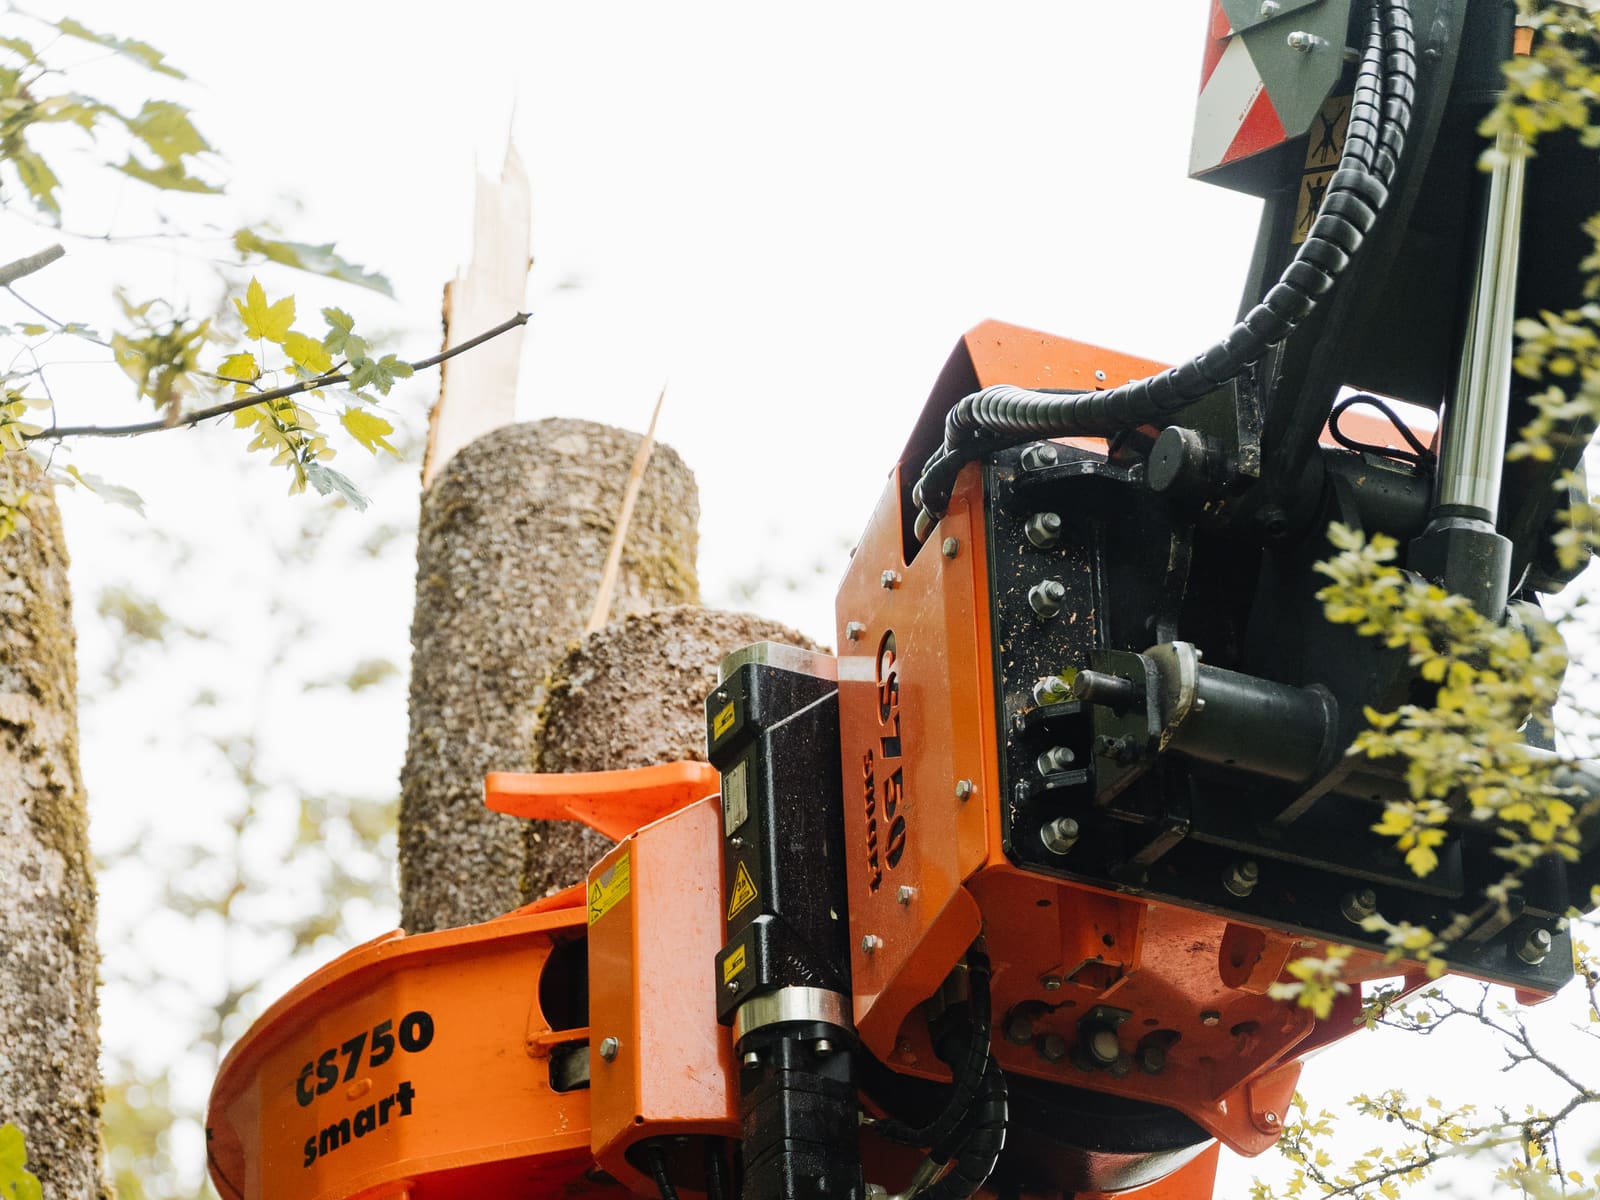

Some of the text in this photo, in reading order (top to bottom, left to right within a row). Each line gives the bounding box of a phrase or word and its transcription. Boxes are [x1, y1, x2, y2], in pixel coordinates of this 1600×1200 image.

[863, 748, 883, 897] smart
[295, 1010, 434, 1107] CS750
[303, 1081, 415, 1168] smart
